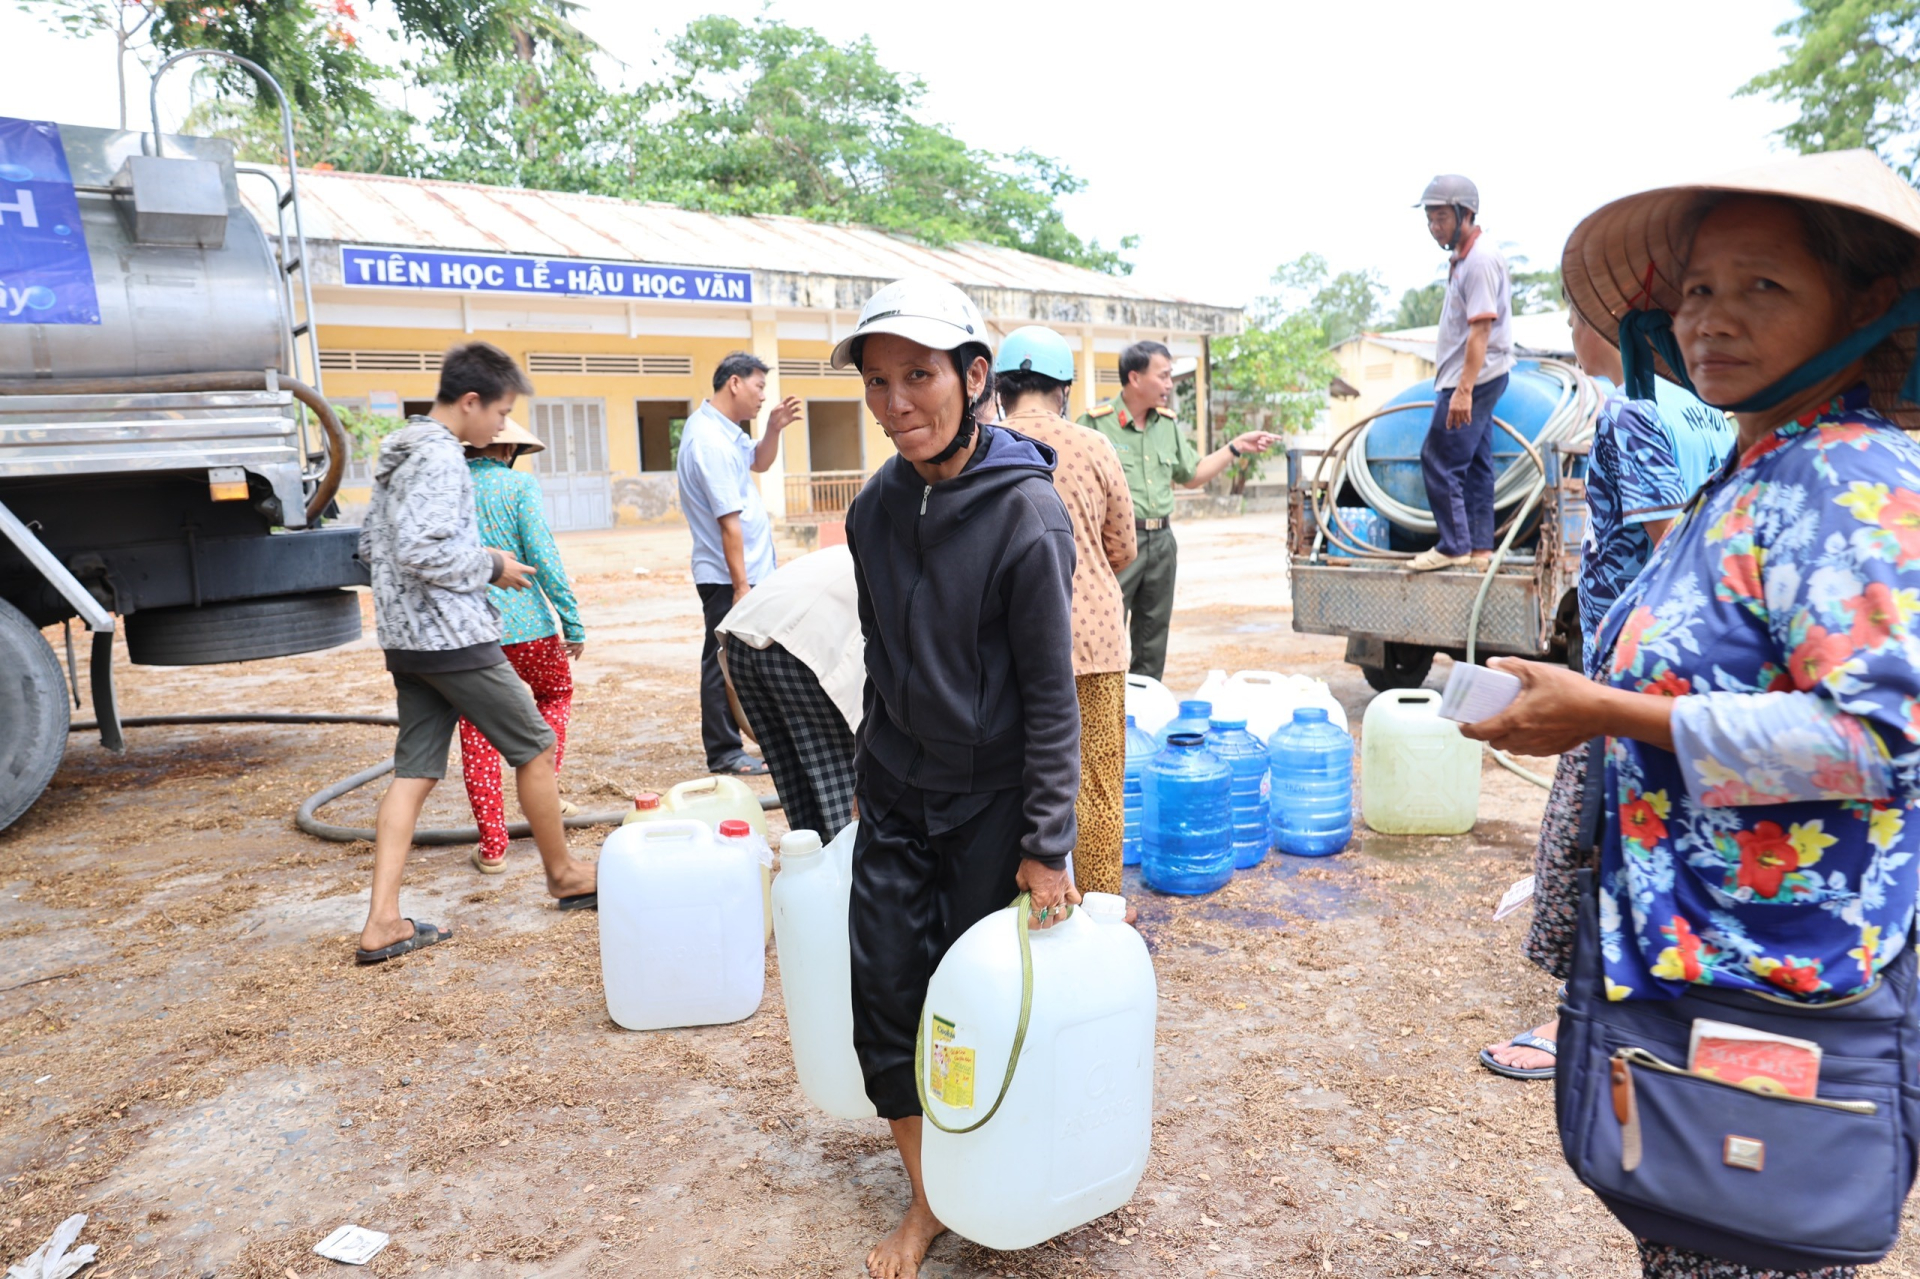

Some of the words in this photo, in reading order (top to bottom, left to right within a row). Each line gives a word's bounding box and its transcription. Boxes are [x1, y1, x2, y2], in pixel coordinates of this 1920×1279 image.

[354, 254, 430, 283] TIÊN
[441, 263, 504, 289] HỌC
[633, 274, 685, 299] HỌC
[694, 273, 744, 299] VĂN
